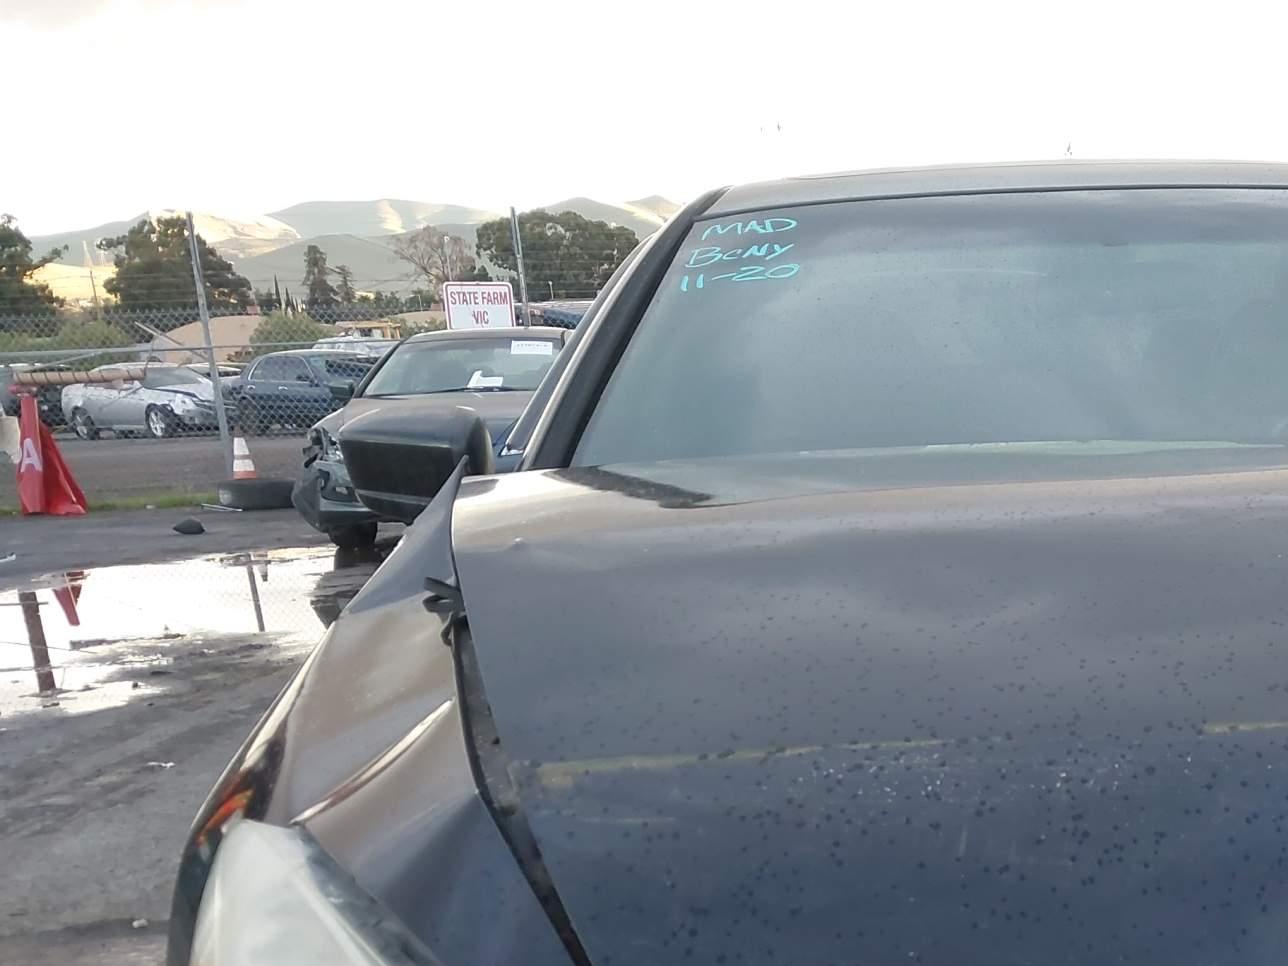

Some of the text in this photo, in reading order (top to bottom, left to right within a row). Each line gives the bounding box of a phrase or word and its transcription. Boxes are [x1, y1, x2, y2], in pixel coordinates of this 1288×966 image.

[701, 218, 798, 241] MAD
[449, 291, 509, 305] STATE FARM
[472, 310, 490, 325] VIC
